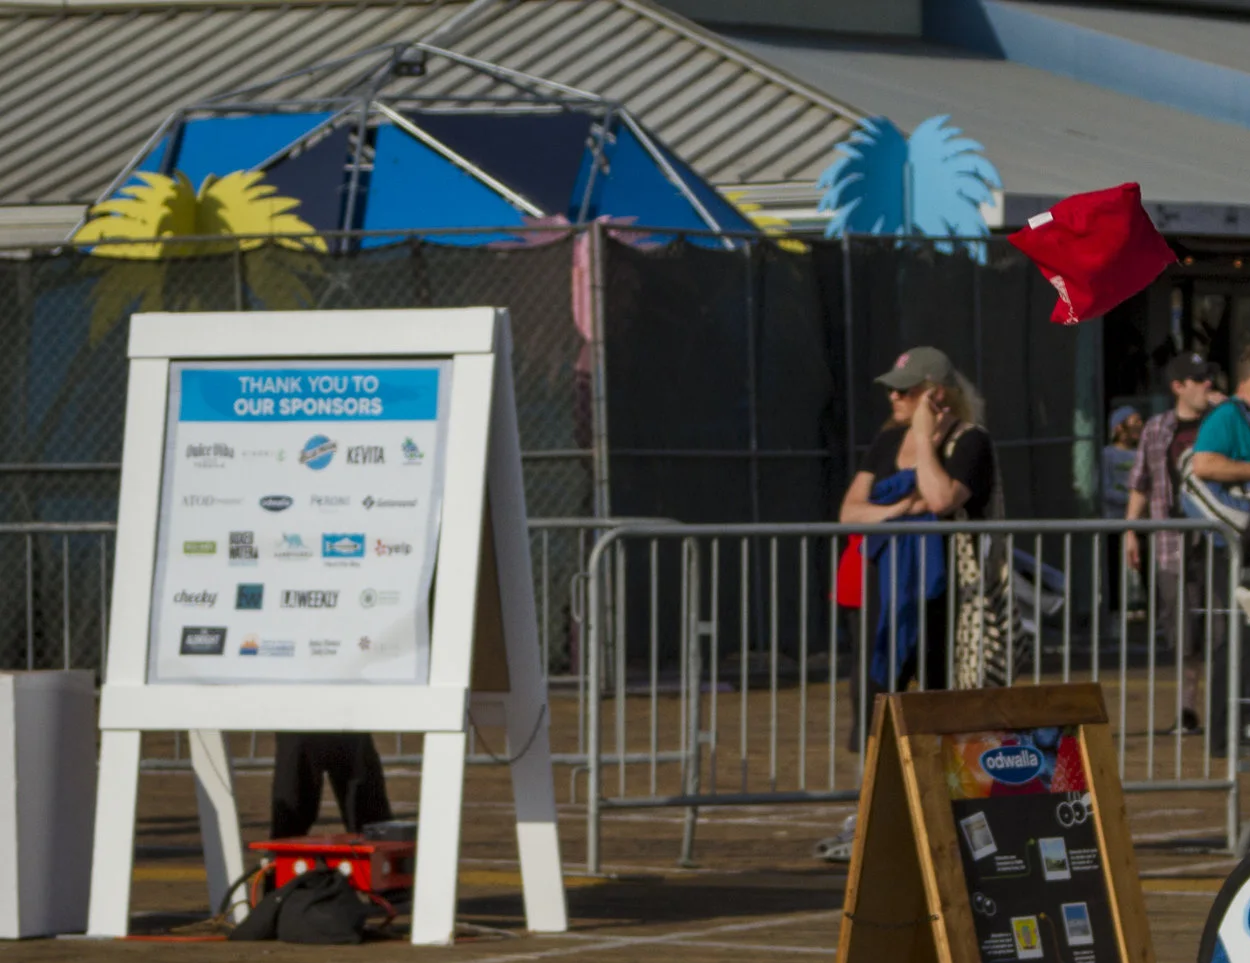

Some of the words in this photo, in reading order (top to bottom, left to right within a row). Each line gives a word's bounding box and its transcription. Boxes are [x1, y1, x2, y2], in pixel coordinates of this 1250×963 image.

[239, 376, 302, 393] THANK
[308, 376, 348, 393] YOU
[352, 375, 380, 393] TO
[234, 398, 275, 416] OUR
[279, 397, 383, 416] SPONSORS
[346, 444, 385, 464] KEVITA
[387, 542, 413, 556] yelp
[174, 589, 218, 608] cheeky
[986, 750, 1038, 769] odwalla
